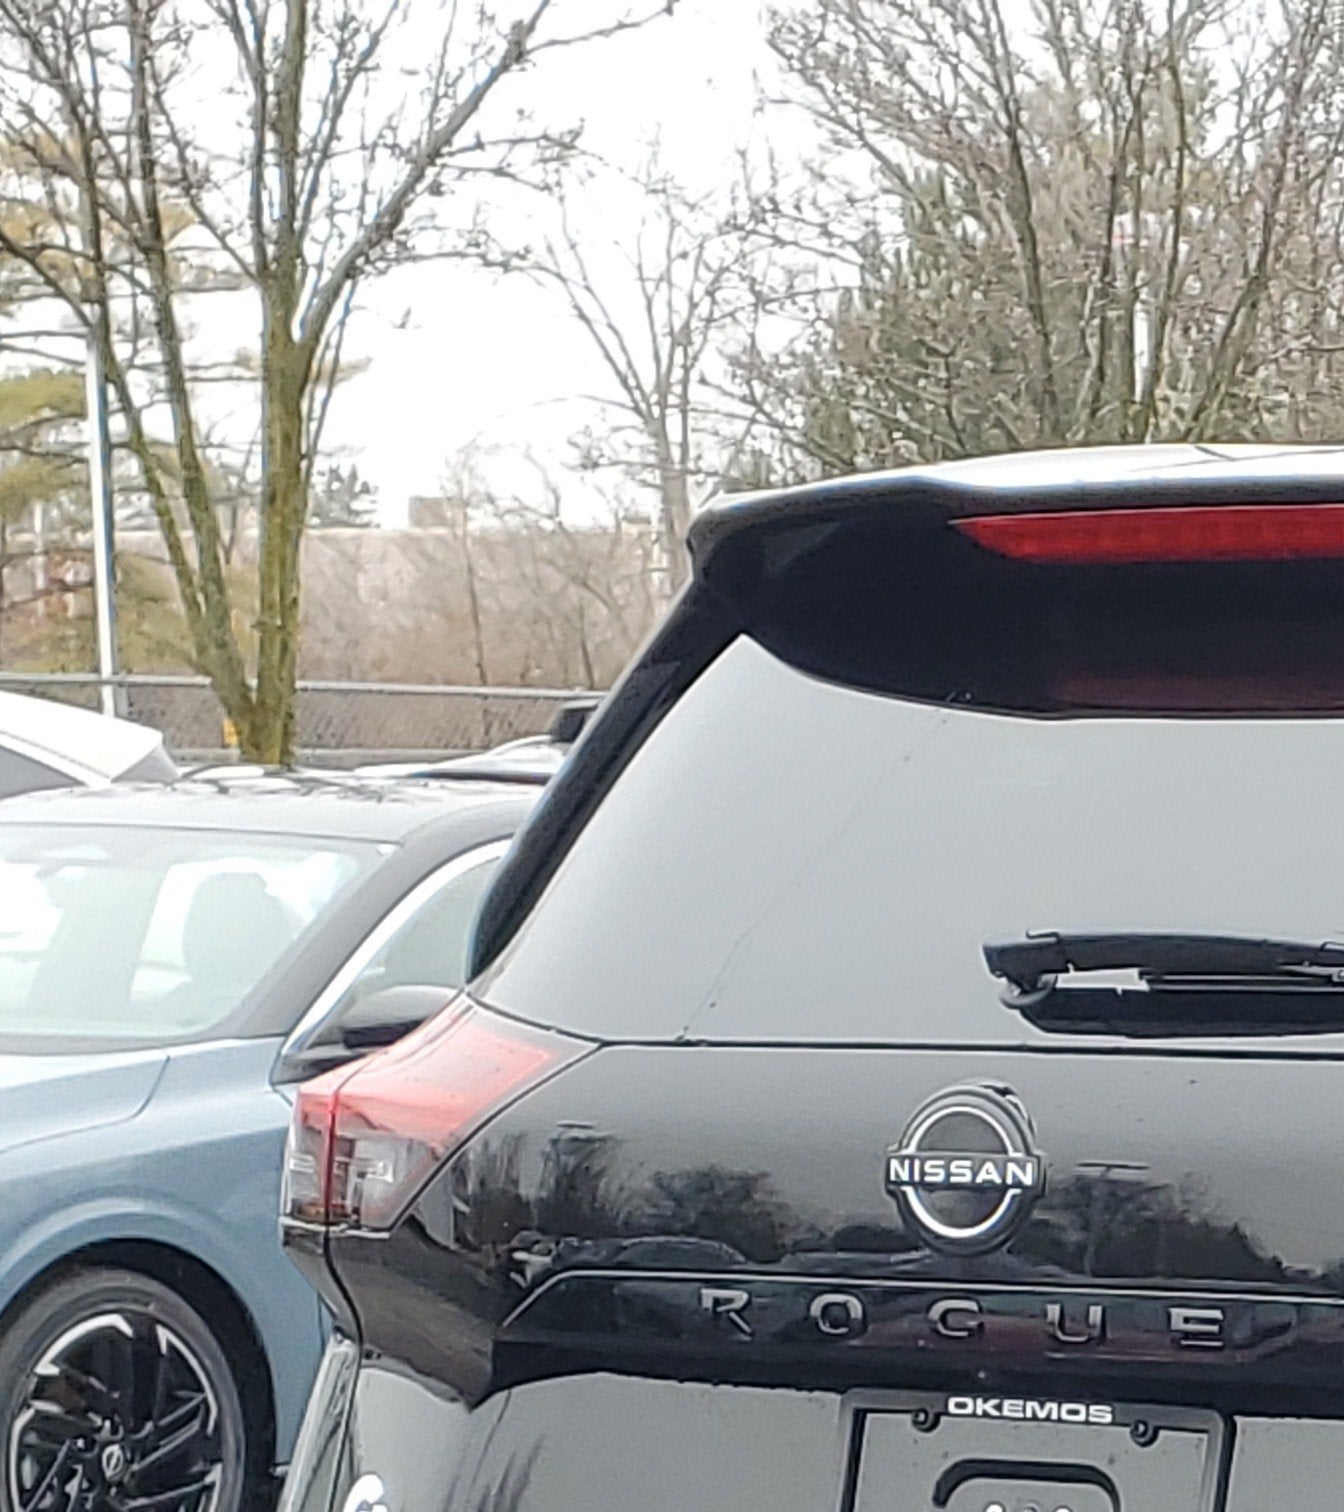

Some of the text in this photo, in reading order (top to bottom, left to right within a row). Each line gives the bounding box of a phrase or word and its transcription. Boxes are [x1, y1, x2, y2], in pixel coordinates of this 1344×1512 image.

[889, 1158, 1033, 1186] NISSAN
[701, 1289, 1224, 1347] ROGUE
[948, 1397, 1113, 1424] OKEMOS
